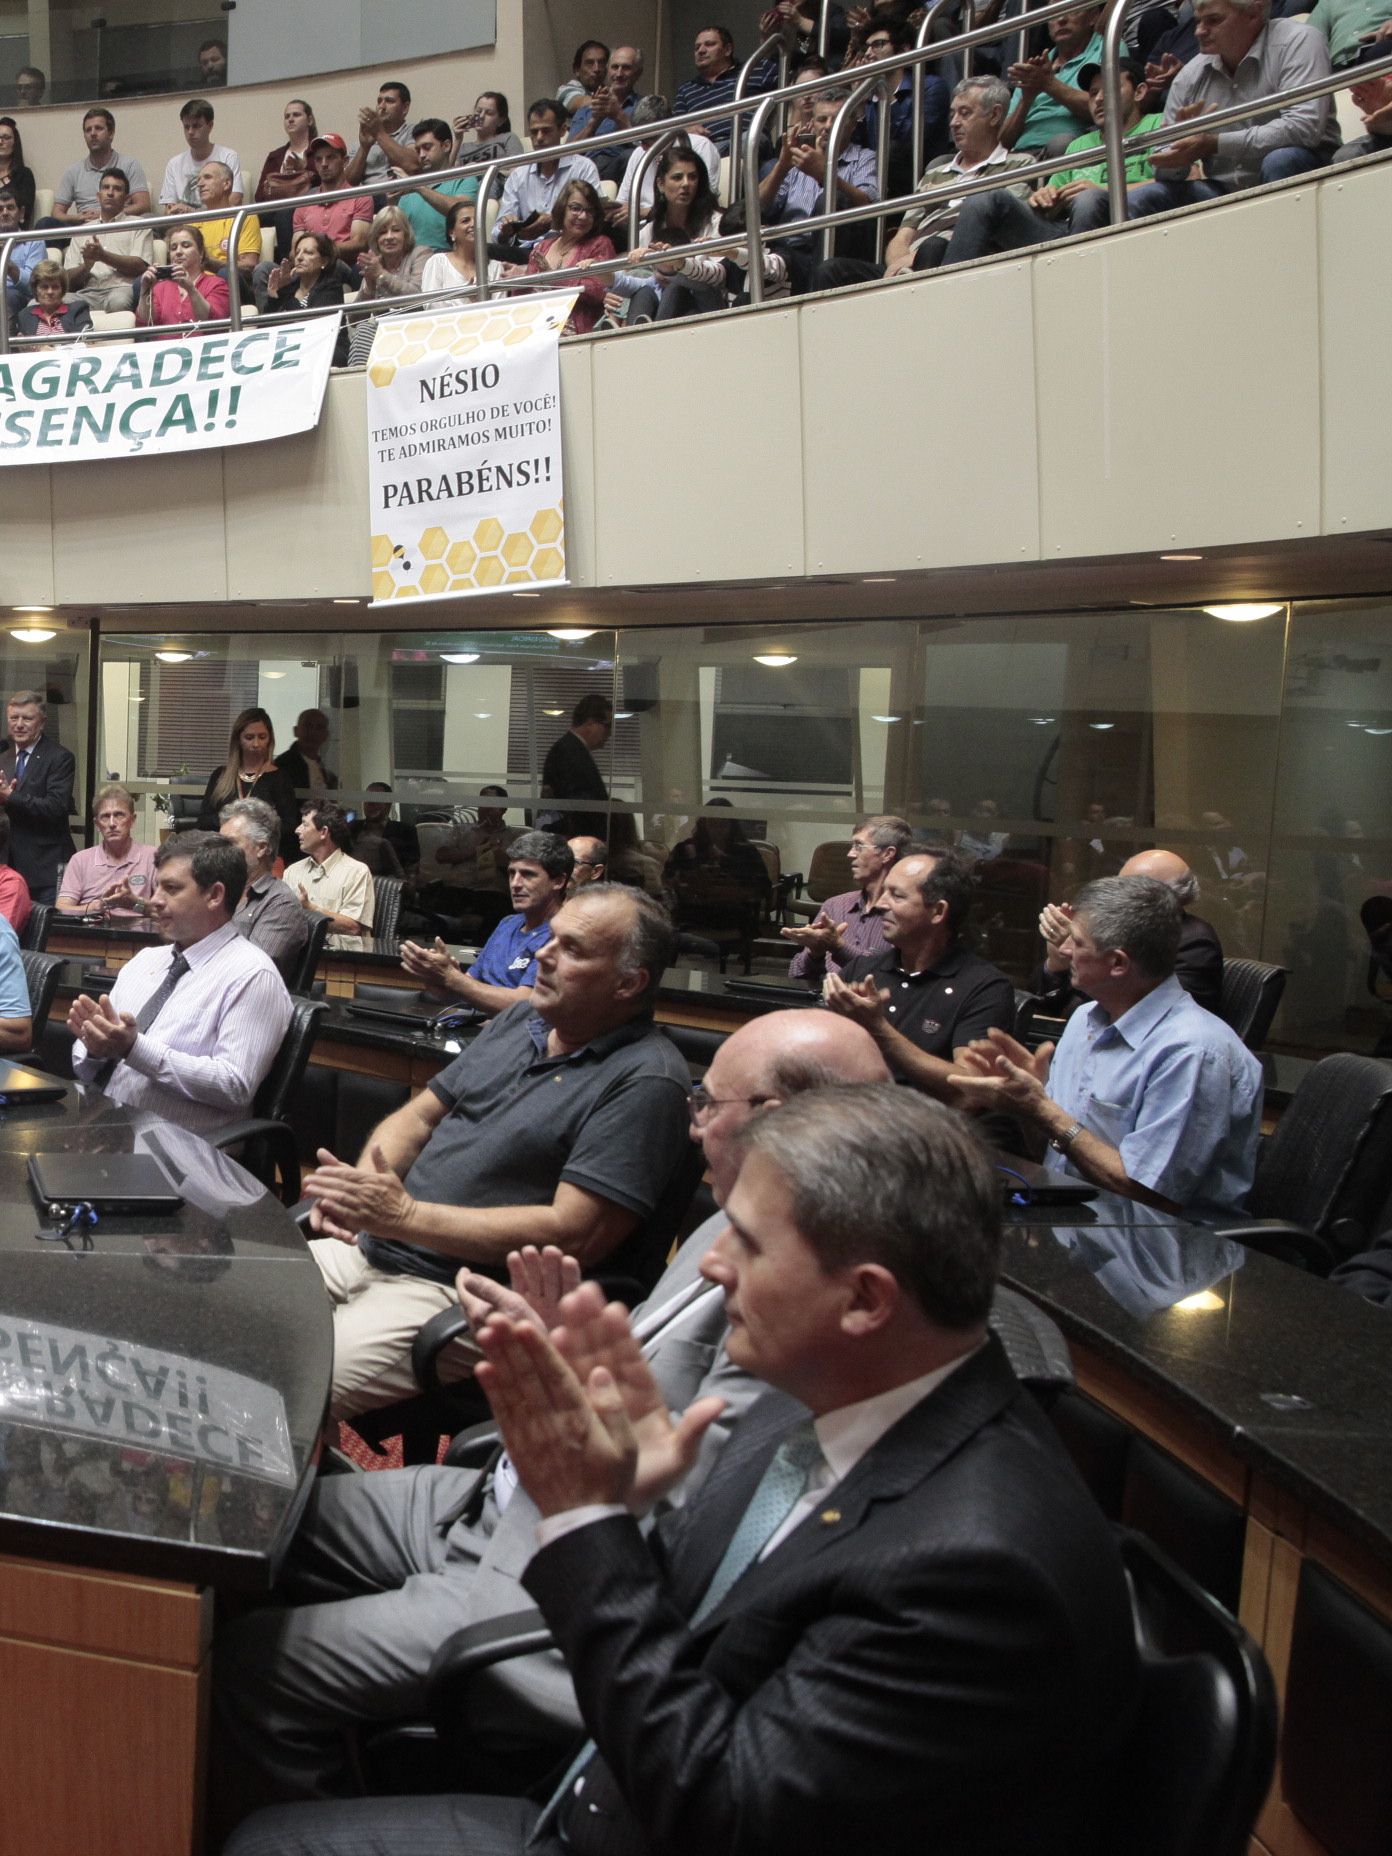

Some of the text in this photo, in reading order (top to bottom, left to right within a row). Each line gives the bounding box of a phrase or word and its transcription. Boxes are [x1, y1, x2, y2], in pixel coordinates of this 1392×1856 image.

[419, 363, 500, 403] NÉSIO
[372, 393, 557, 443] TEMOS ORGULHO DE VOCÊ!
[377, 418, 552, 463] TE ADMIRAMOS MUITO!
[382, 456, 552, 510] PARABÉNS!!
